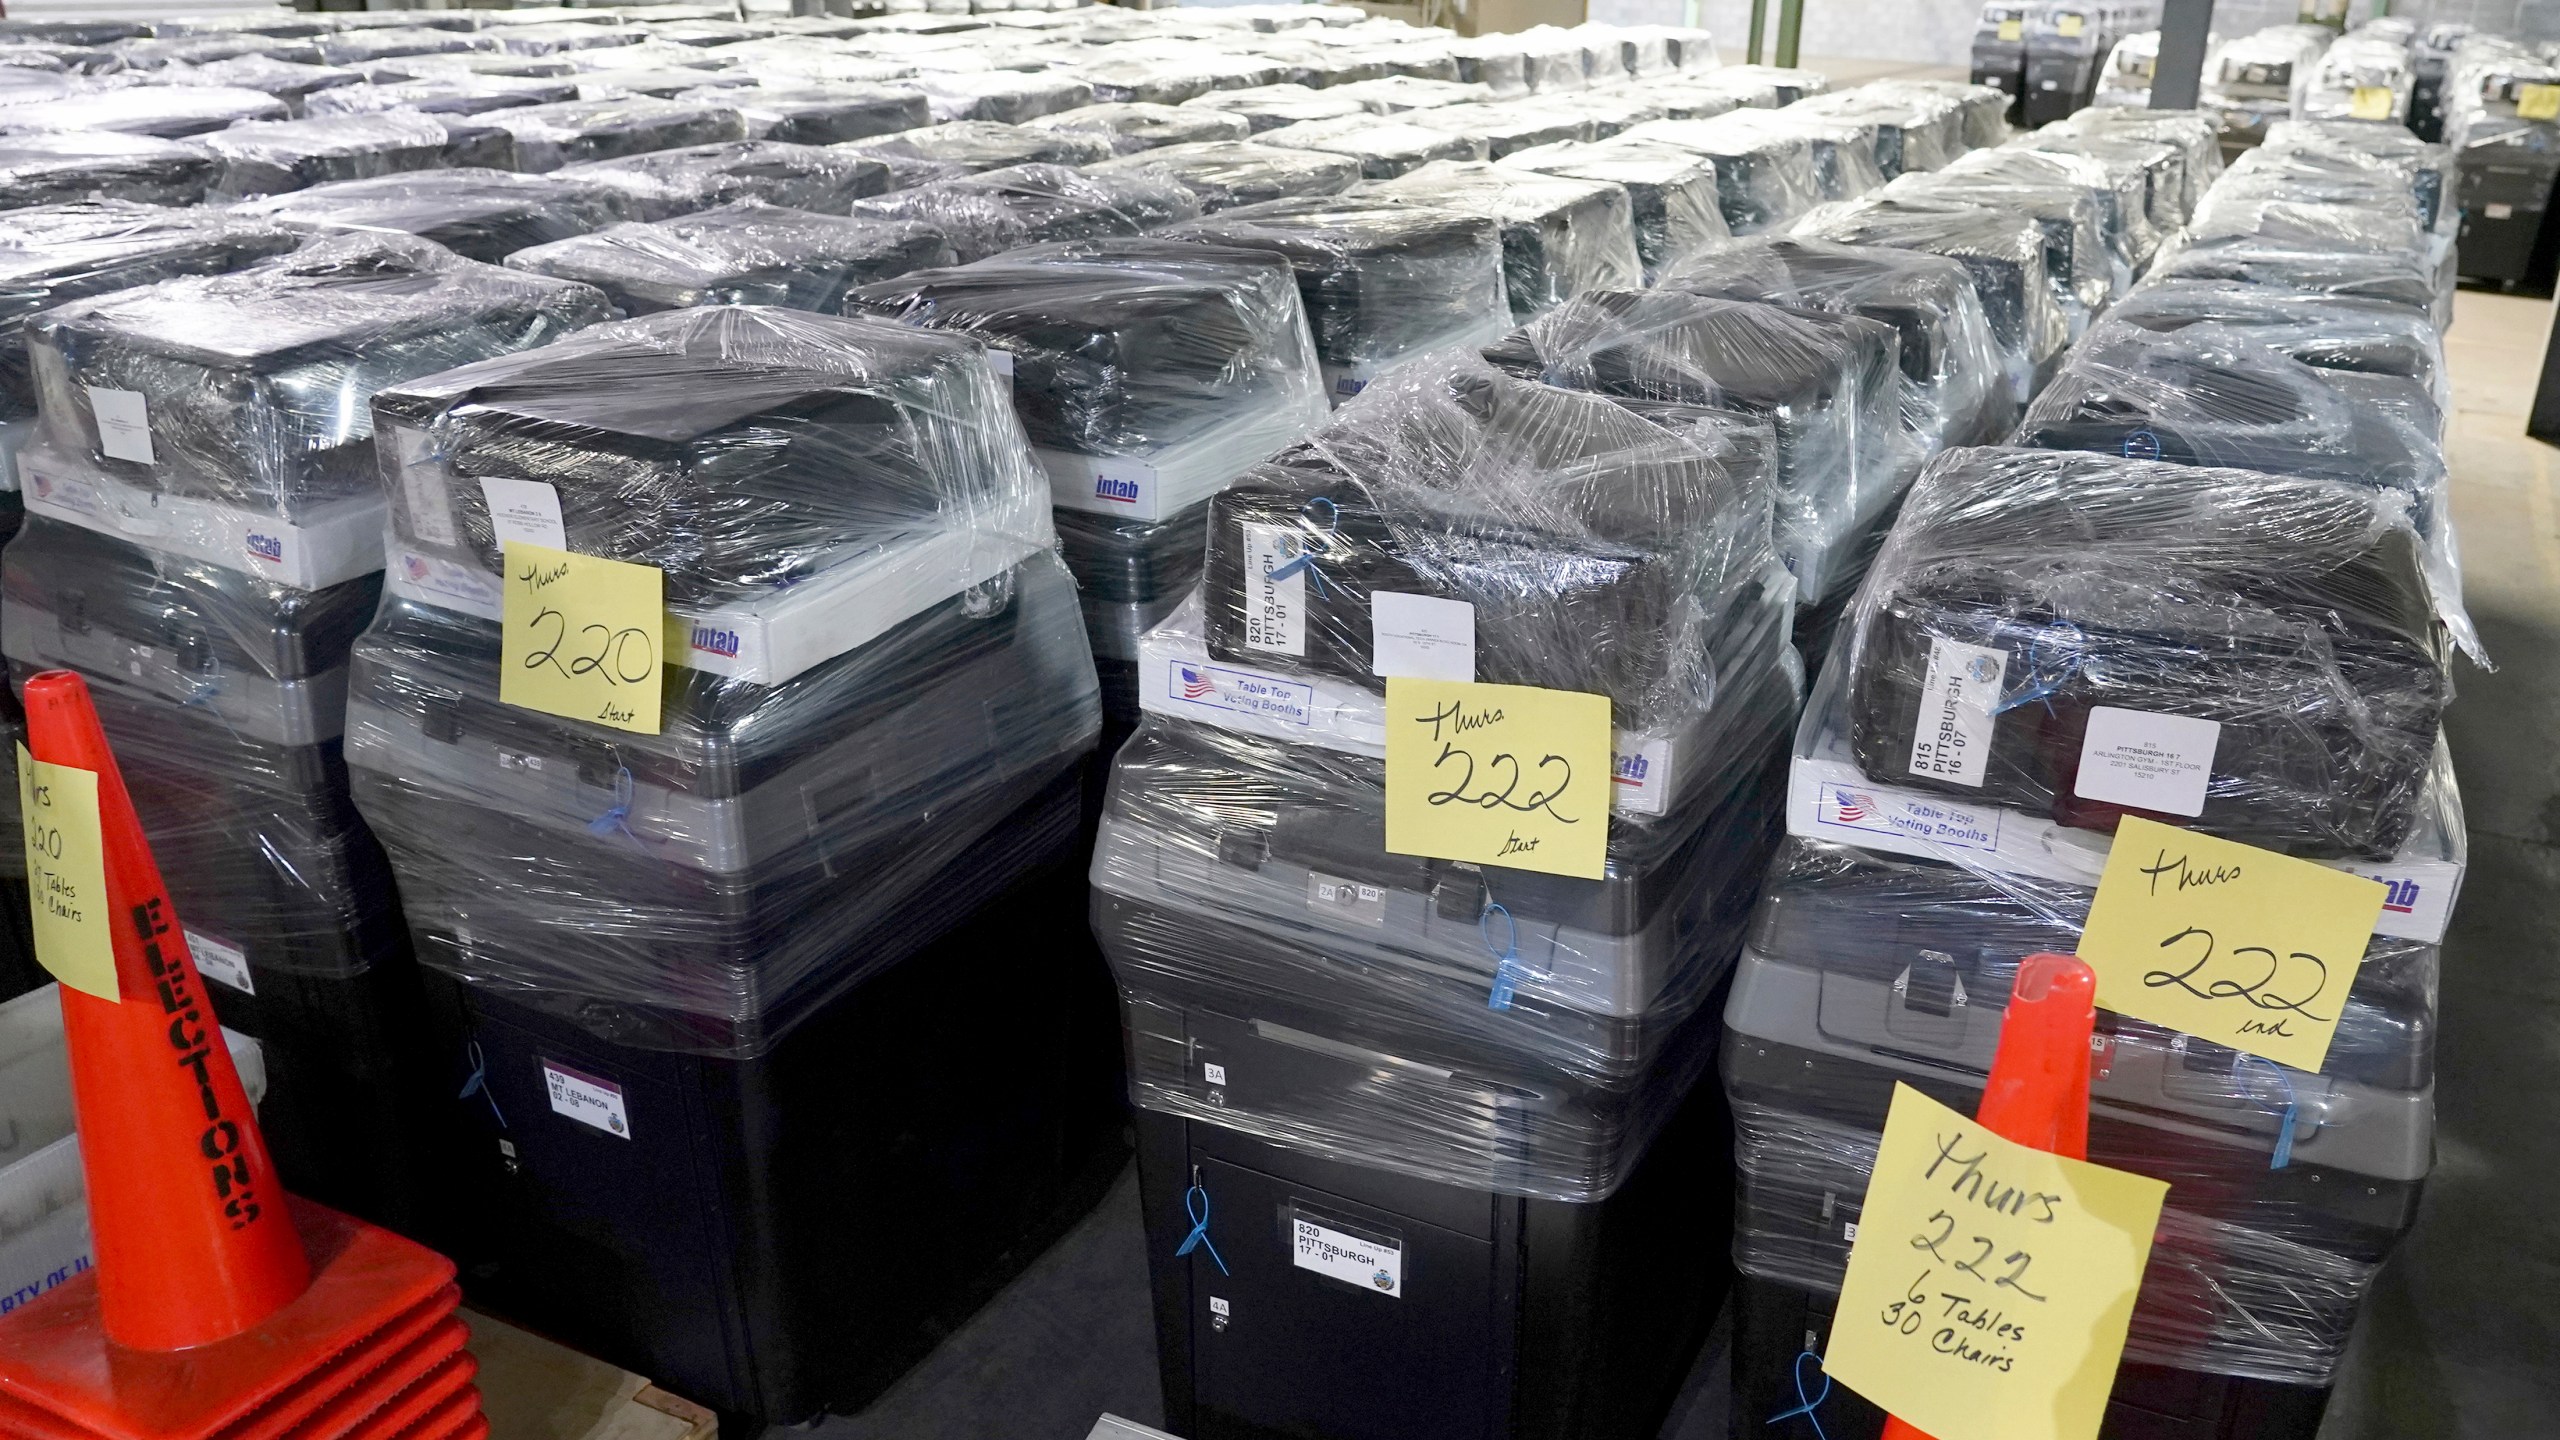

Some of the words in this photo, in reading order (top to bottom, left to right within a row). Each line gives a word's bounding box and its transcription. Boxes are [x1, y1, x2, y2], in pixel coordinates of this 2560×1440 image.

[1246, 543, 1253, 552] Up
[1275, 604, 1287, 618] 01
[691, 619, 740, 655] intab
[1249, 617, 1261, 643] 820
[1275, 632, 1287, 646] 17
[524, 606, 653, 686] 220
[1238, 680, 1267, 695] Table
[1271, 687, 1291, 702] Top
[597, 701, 635, 724] Start
[1223, 691, 1259, 710] Voting
[1262, 699, 1303, 717] Booths
[1933, 676, 1963, 773] PITTSBURGH
[1952, 730, 1967, 747] 07
[1915, 742, 1932, 770] 815
[2093, 750, 2136, 761] ARLINGTON
[2137, 756, 2154, 764] GYM
[2174, 762, 2201, 771] FLOOR
[2116, 746, 2164, 758] PITTSBURGH
[1948, 760, 1963, 775] 16
[2128, 763, 2169, 774] SALISBURY
[2134, 771, 2154, 780] 15210
[1428, 742, 1580, 824] 222
[1907, 802, 1944, 819] Table
[1936, 823, 1989, 842] Booths
[1320, 886, 1334, 898] 2A
[1361, 888, 1377, 898] 820
[48, 895, 82, 923] Chairs
[2143, 926, 2332, 1022] 222
[132, 896, 261, 1231] ELECTIONS
[1208, 1067, 1224, 1081] 3A
[549, 1072, 566, 1085] 439
[551, 1082, 564, 1094] MT
[565, 1087, 609, 1111] LEBANON
[1298, 1223, 1320, 1238] 820
[1299, 1235, 1375, 1266] PITTSBURGH
[1299, 1245, 1311, 1255] 17
[1321, 1251, 1334, 1262] 01
[1910, 1209, 2047, 1302] 222
[1212, 1301, 1228, 1313] 4A
[1908, 1269, 1931, 1304] 6
[1941, 1292, 2025, 1341] Tables
[1881, 1301, 1921, 1335] 30
[1932, 1328, 2014, 1372] Chairs
